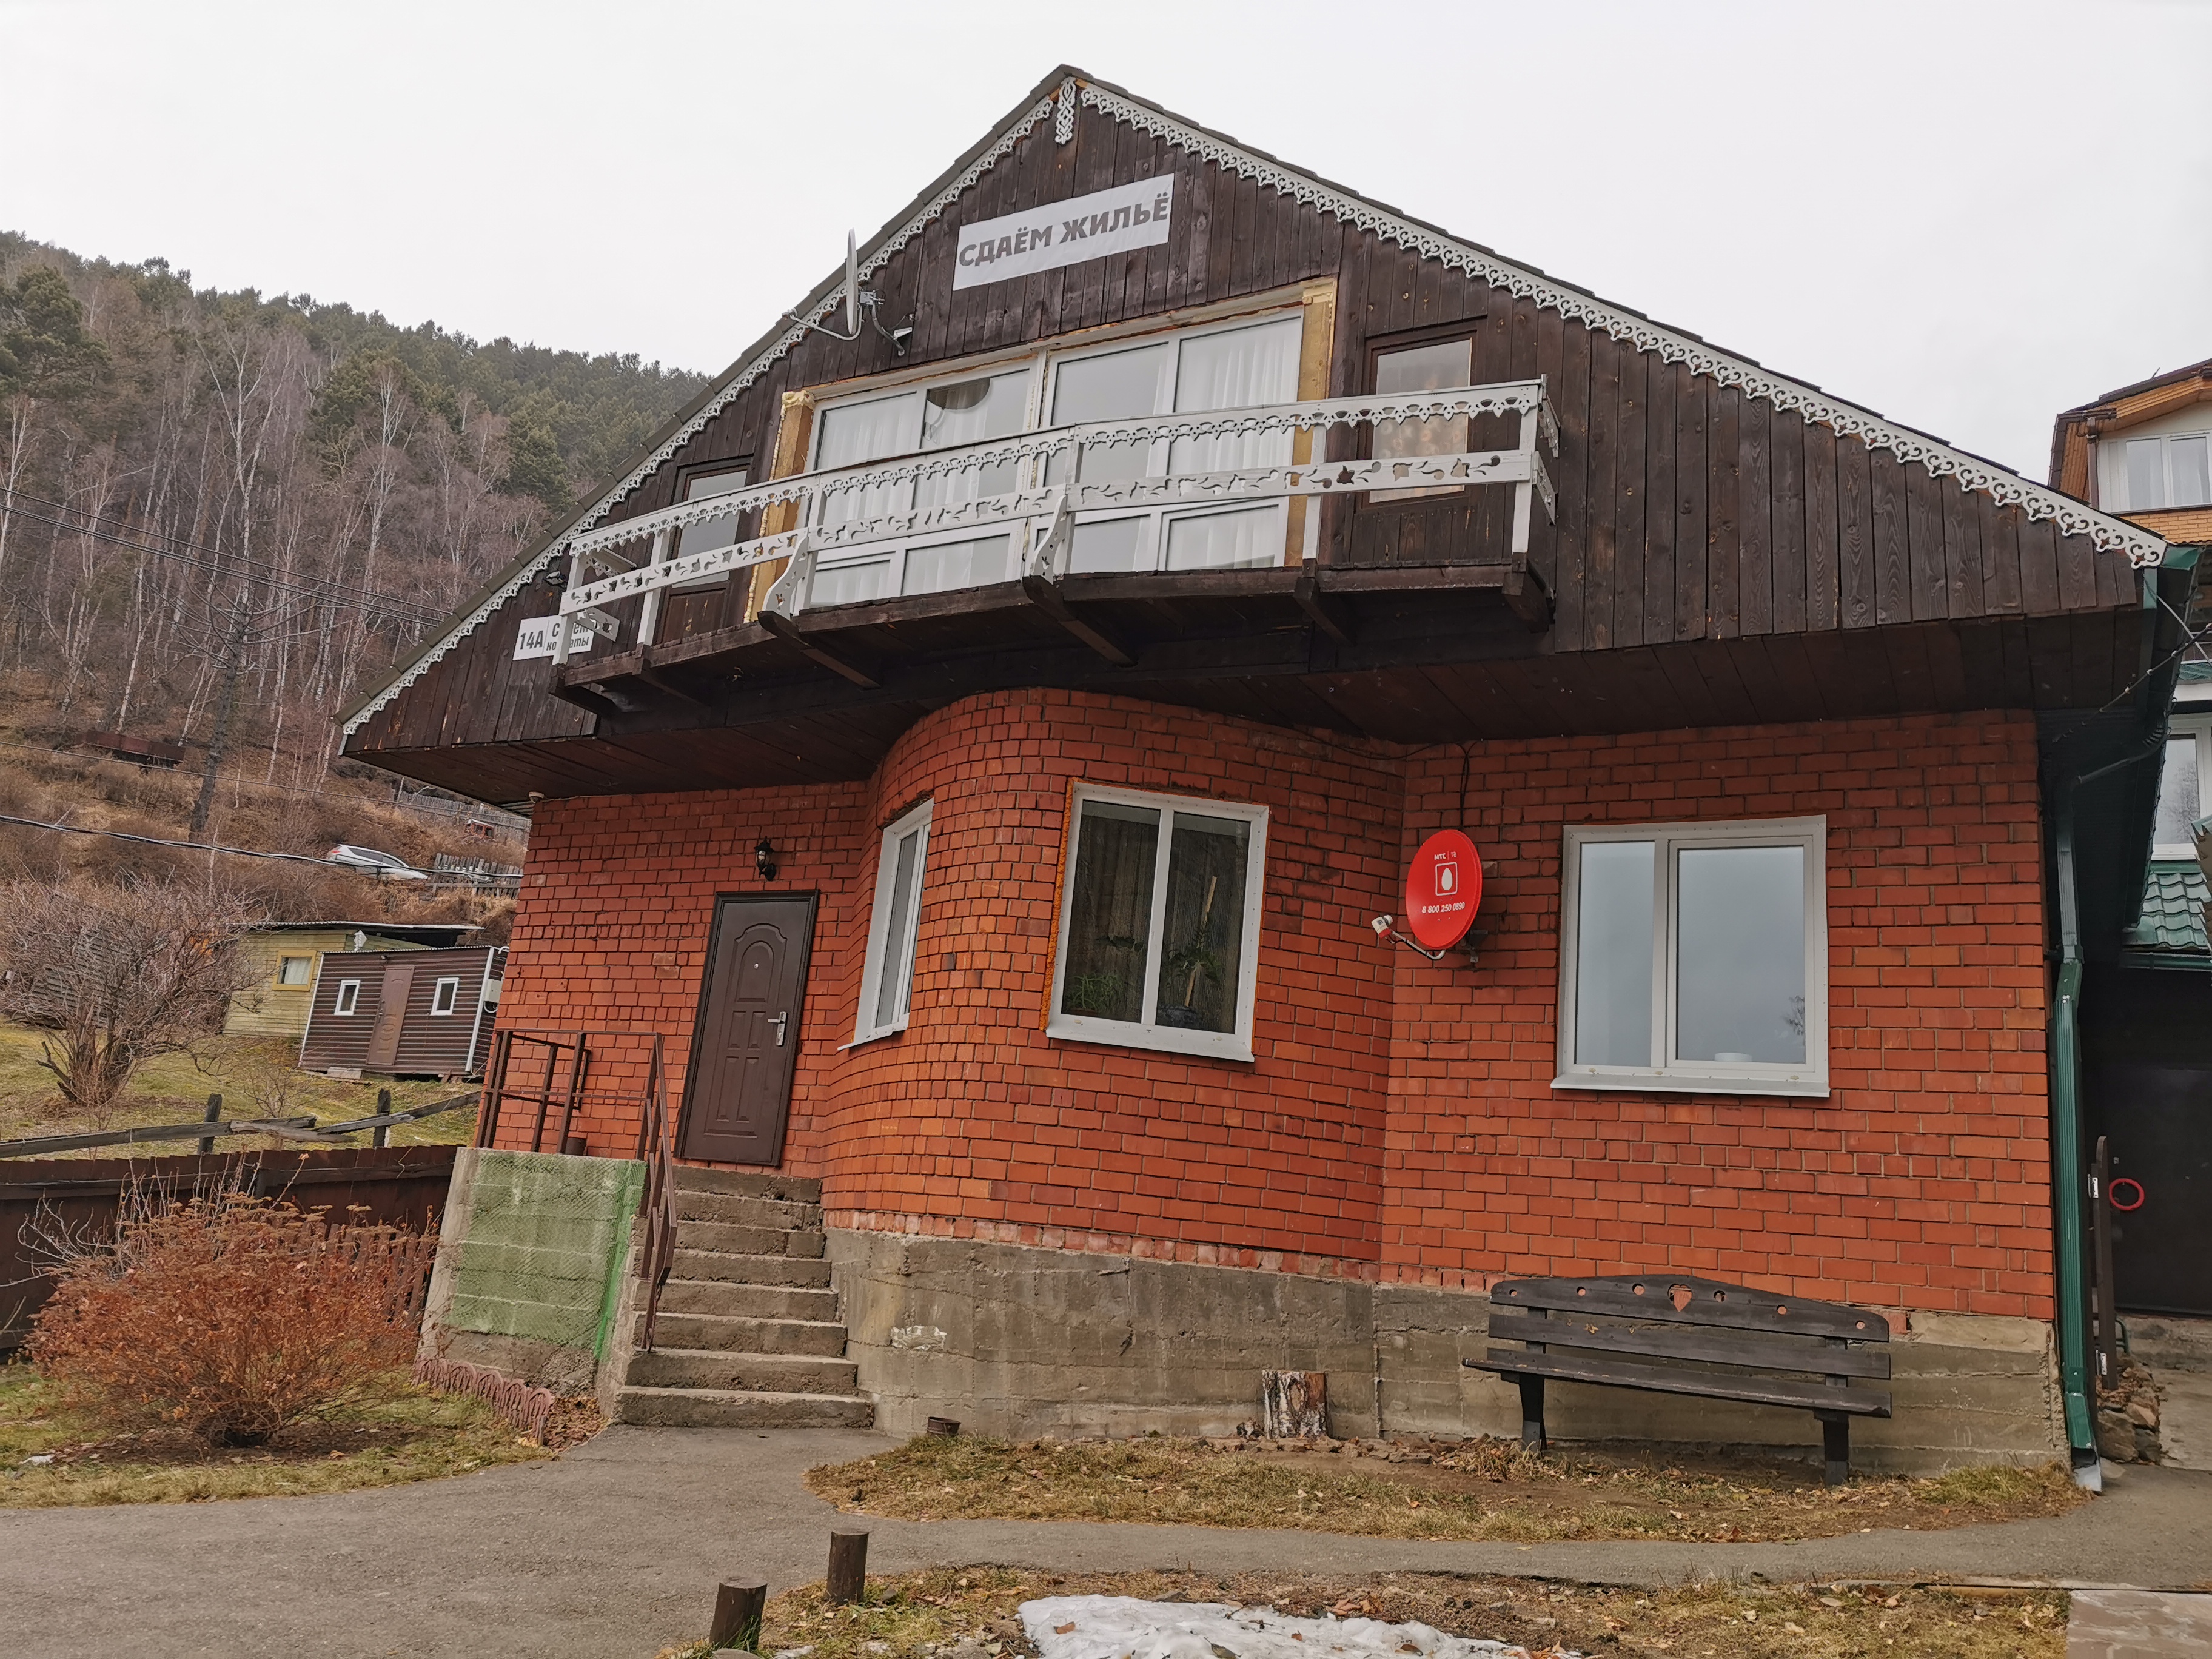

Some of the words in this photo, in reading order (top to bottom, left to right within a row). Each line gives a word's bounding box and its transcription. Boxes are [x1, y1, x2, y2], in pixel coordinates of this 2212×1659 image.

[959, 226, 1053, 267] СДАЁМ
[1059, 192, 1170, 244] ЖИЛЬЁ
[520, 630, 544, 650] 14А
[546, 637, 589, 651] коаты
[1421, 905, 1427, 914] 8
[1427, 905, 1440, 914] 800
[1441, 903, 1452, 913] 250
